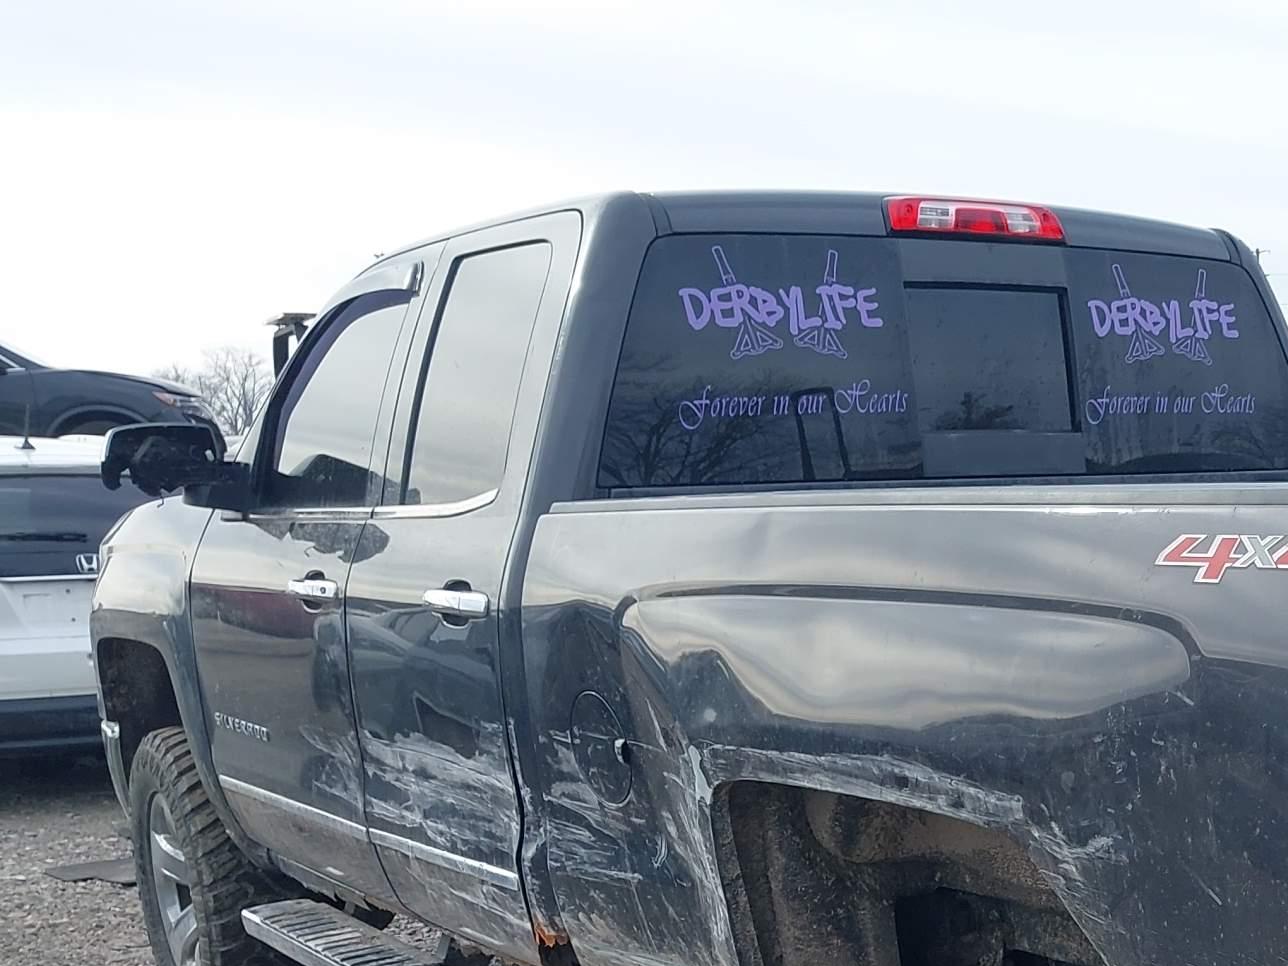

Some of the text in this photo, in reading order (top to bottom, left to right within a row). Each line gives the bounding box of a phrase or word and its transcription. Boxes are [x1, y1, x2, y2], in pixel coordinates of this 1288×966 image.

[678, 283, 884, 336] DERBYLIFE
[1086, 296, 1240, 344] DERBYLIFE
[678, 379, 909, 430] Forever in our Hearts
[1085, 382, 1257, 425] Forever in our Hearts
